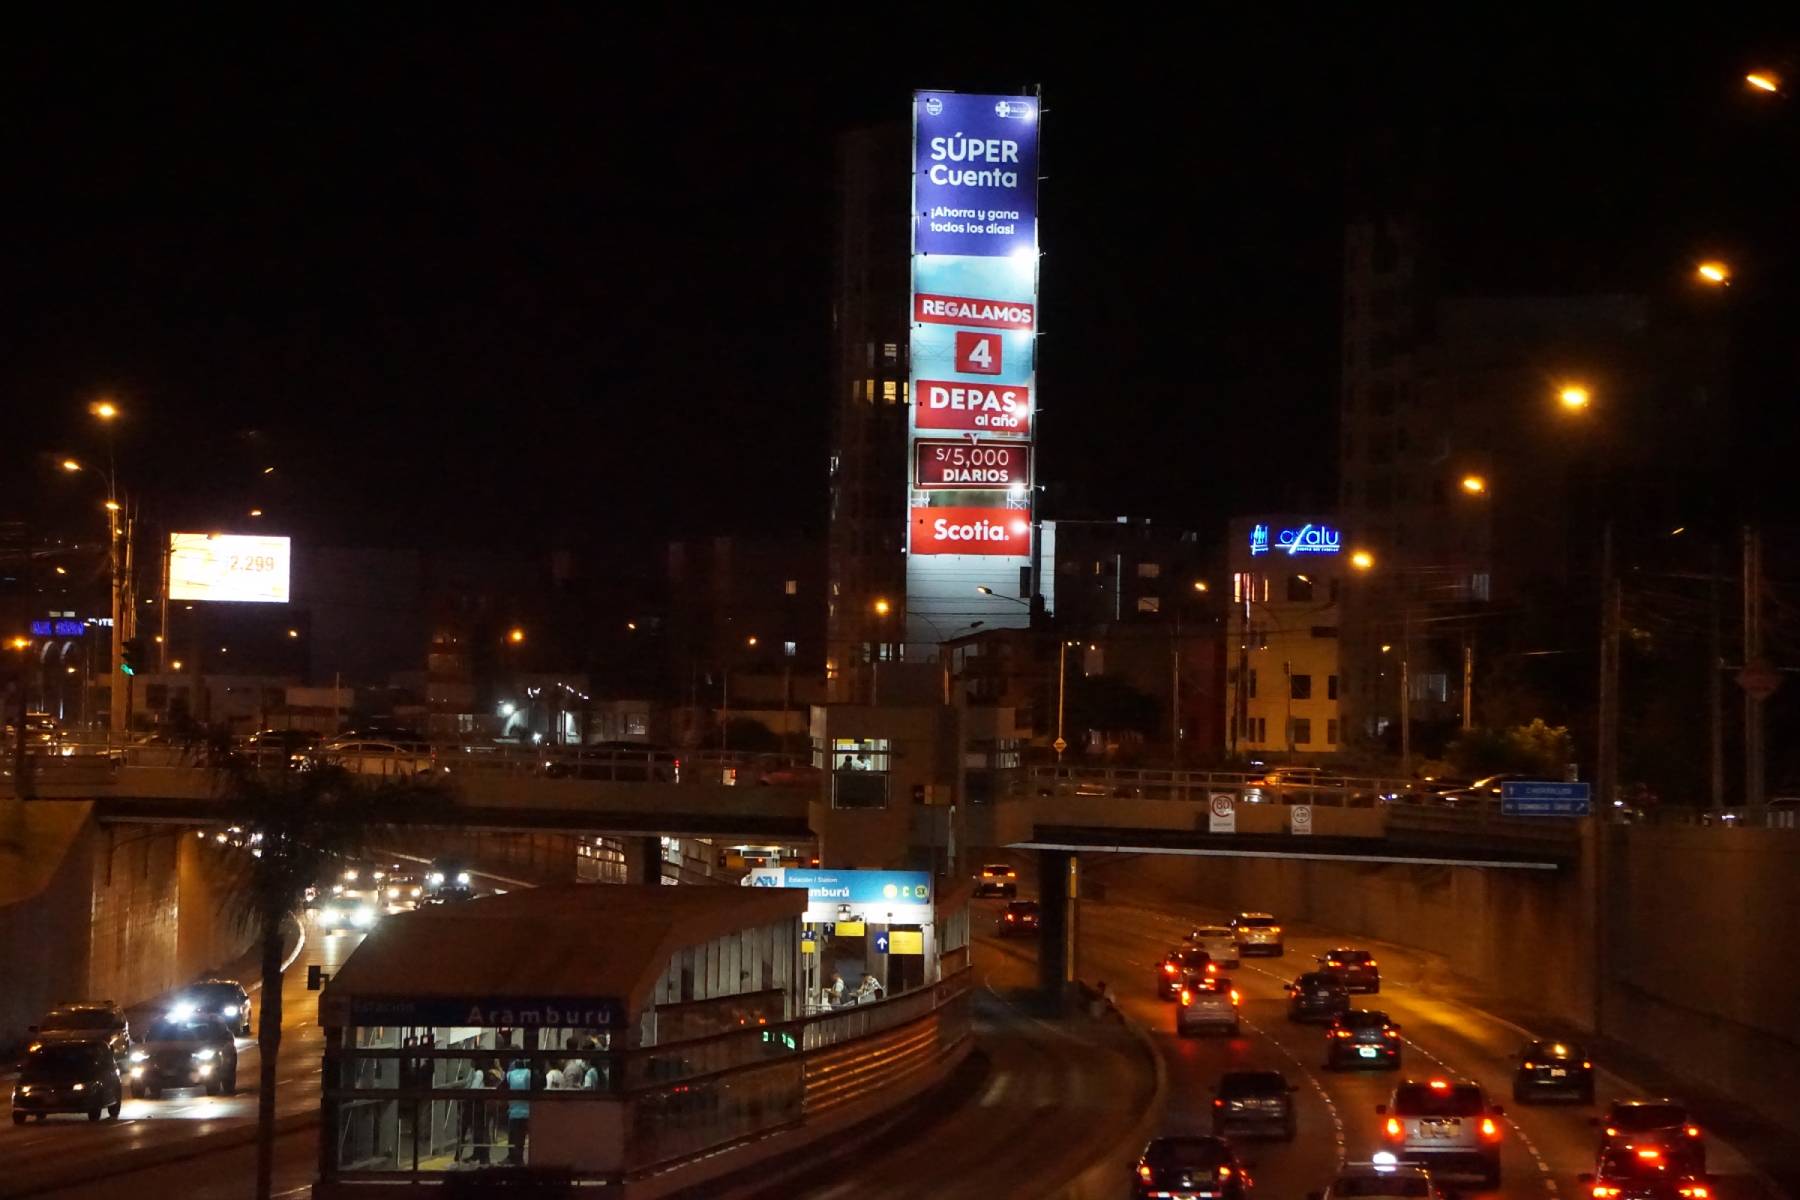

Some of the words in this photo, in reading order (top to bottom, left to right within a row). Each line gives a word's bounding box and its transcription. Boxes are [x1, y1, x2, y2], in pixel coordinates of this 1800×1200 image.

[931, 132, 1019, 163] SÚPER
[929, 164, 1018, 188] Cuenta
[931, 206, 975, 219] ¡Ahorra
[977, 210, 985, 221] y
[987, 209, 1019, 221] gana
[930, 221, 964, 233] todos
[966, 222, 984, 234] los
[985, 222, 1015, 235] días!
[922, 299, 1032, 323] REGALAMOS
[968, 339, 993, 369] 4
[930, 386, 1017, 412] DEPAS
[974, 413, 988, 426] al
[991, 413, 1018, 428] año
[936, 448, 1009, 468] S/5,000
[943, 469, 1009, 482] DIARIOS
[934, 518, 1010, 541] Scotia.
[754, 875, 778, 887] ATU
[809, 886, 850, 898] mburú
[468, 1004, 611, 1024] Aramburú
